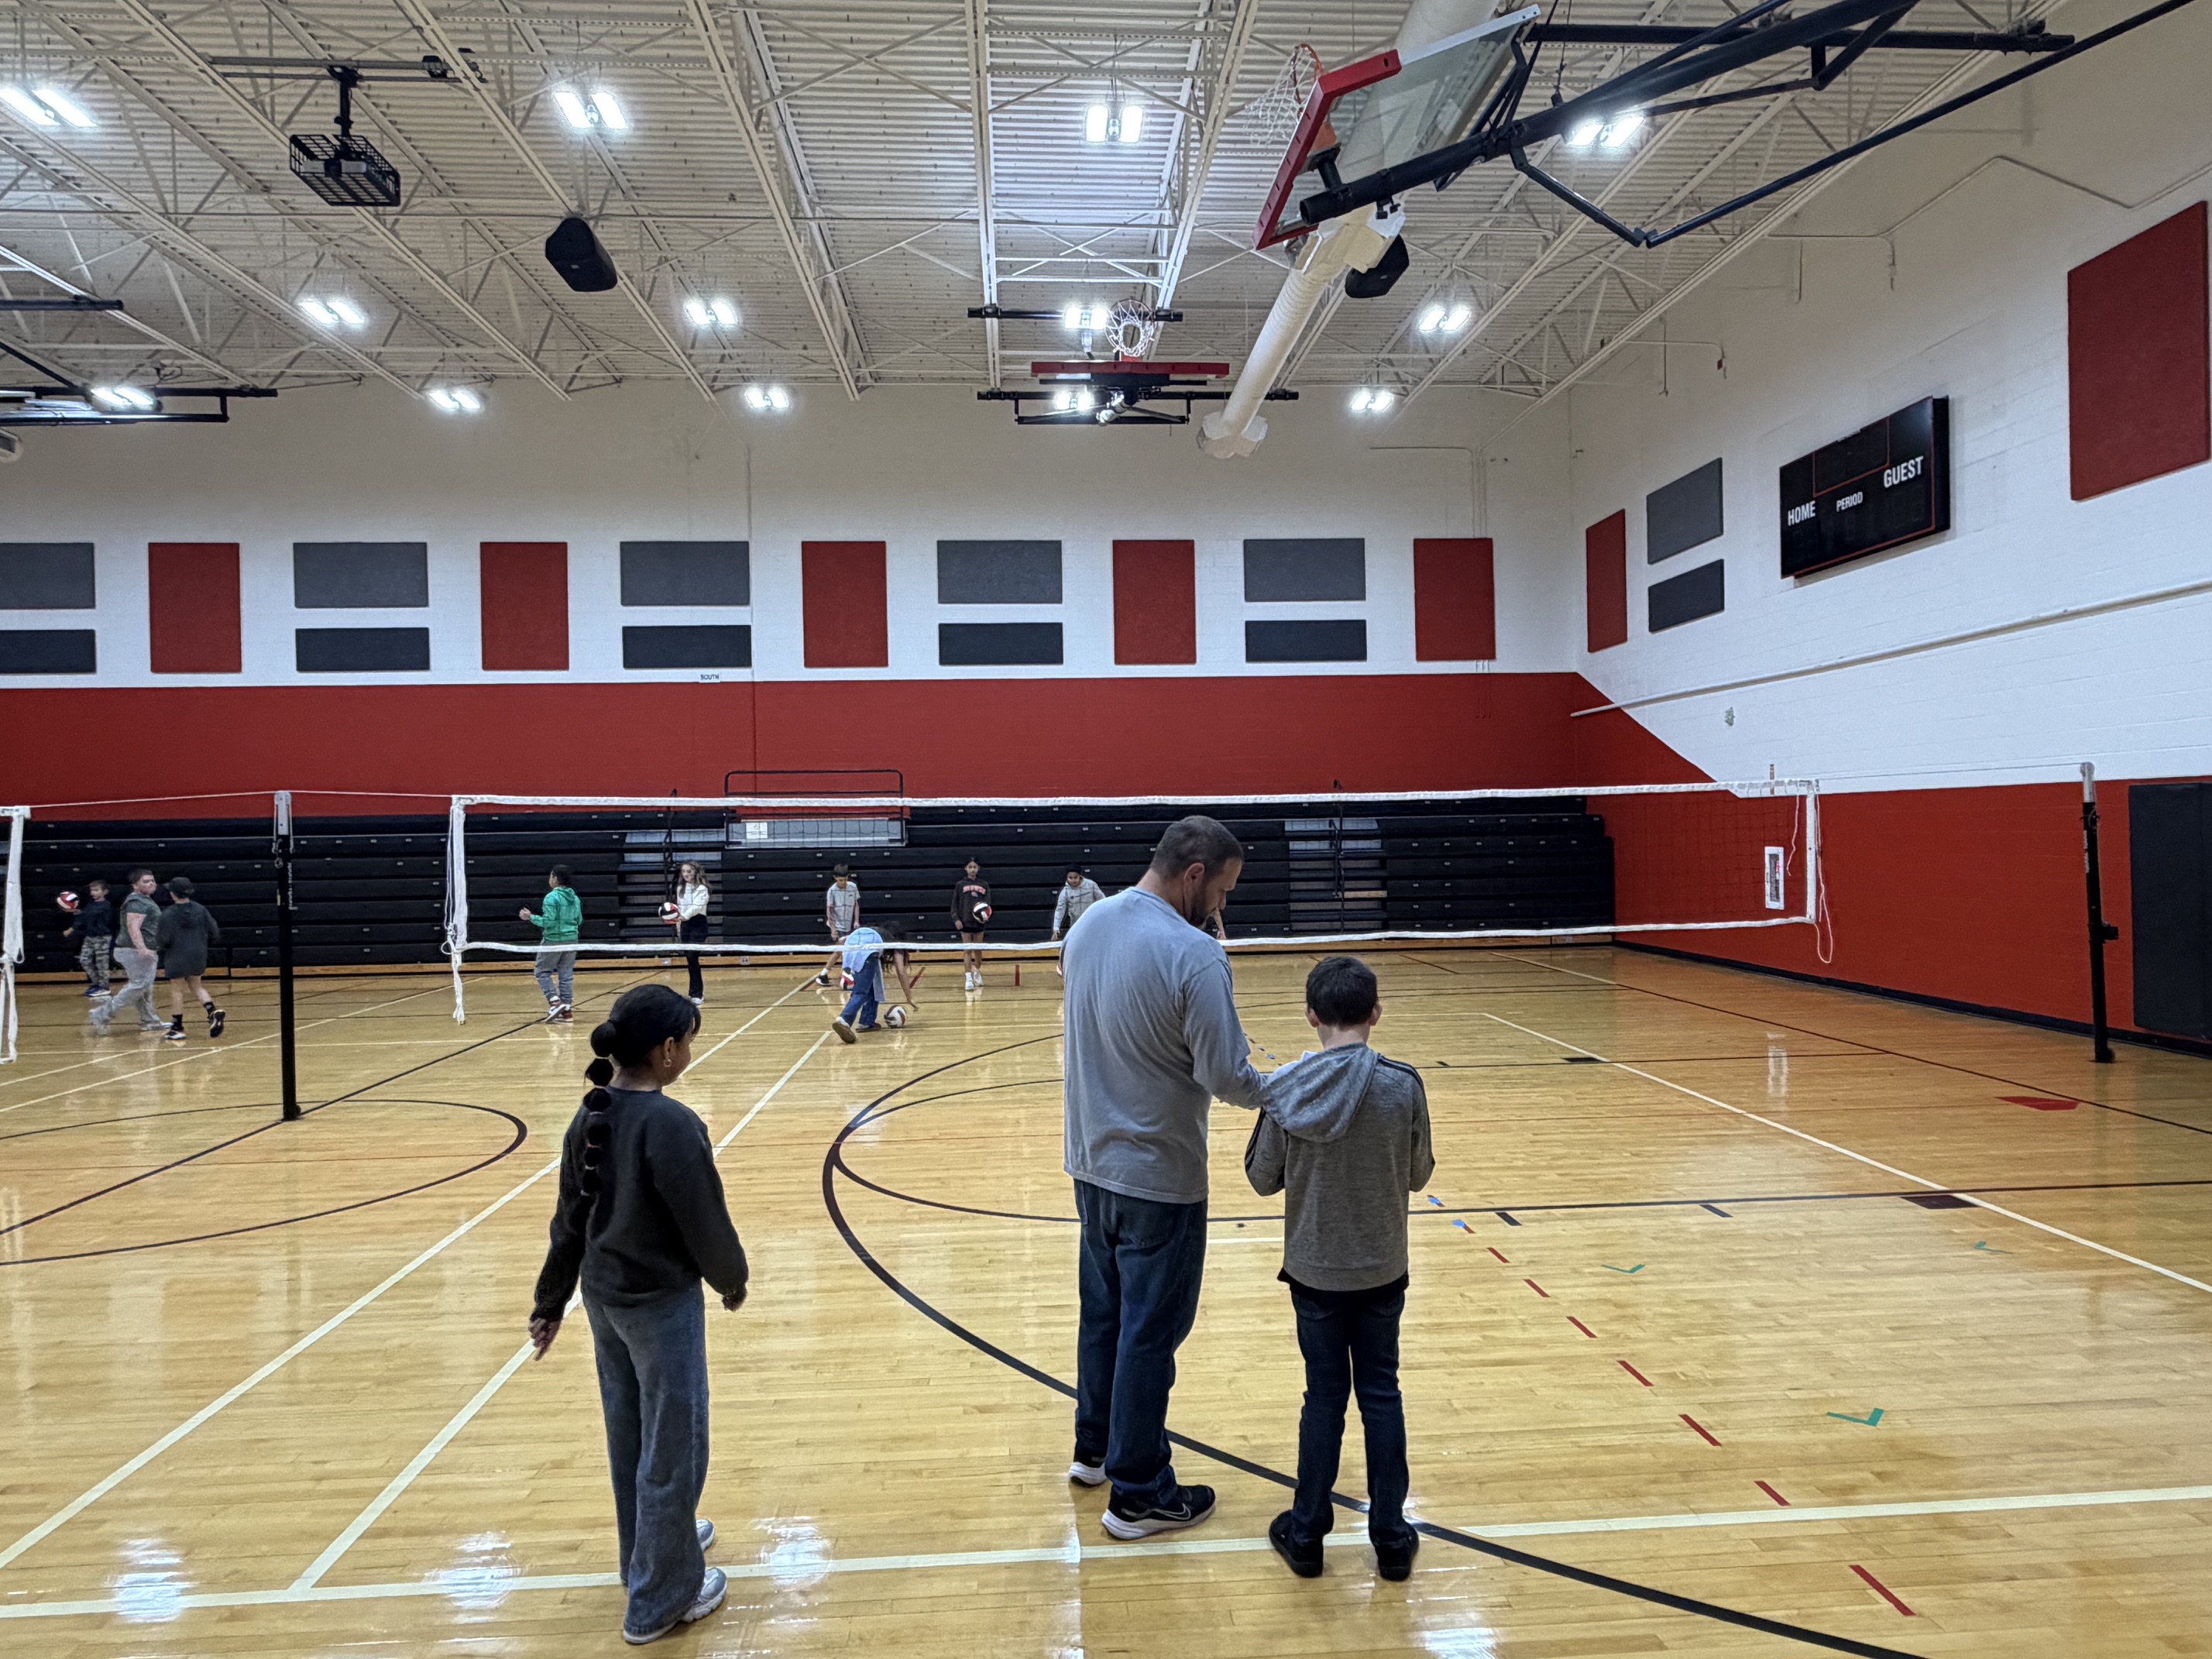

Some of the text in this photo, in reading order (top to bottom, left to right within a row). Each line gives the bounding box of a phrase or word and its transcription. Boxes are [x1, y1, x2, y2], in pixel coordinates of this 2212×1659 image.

[1884, 455, 1924, 489] GUEST
[1788, 500, 1816, 526] HOME
[1836, 491, 1863, 513] PERIOD
